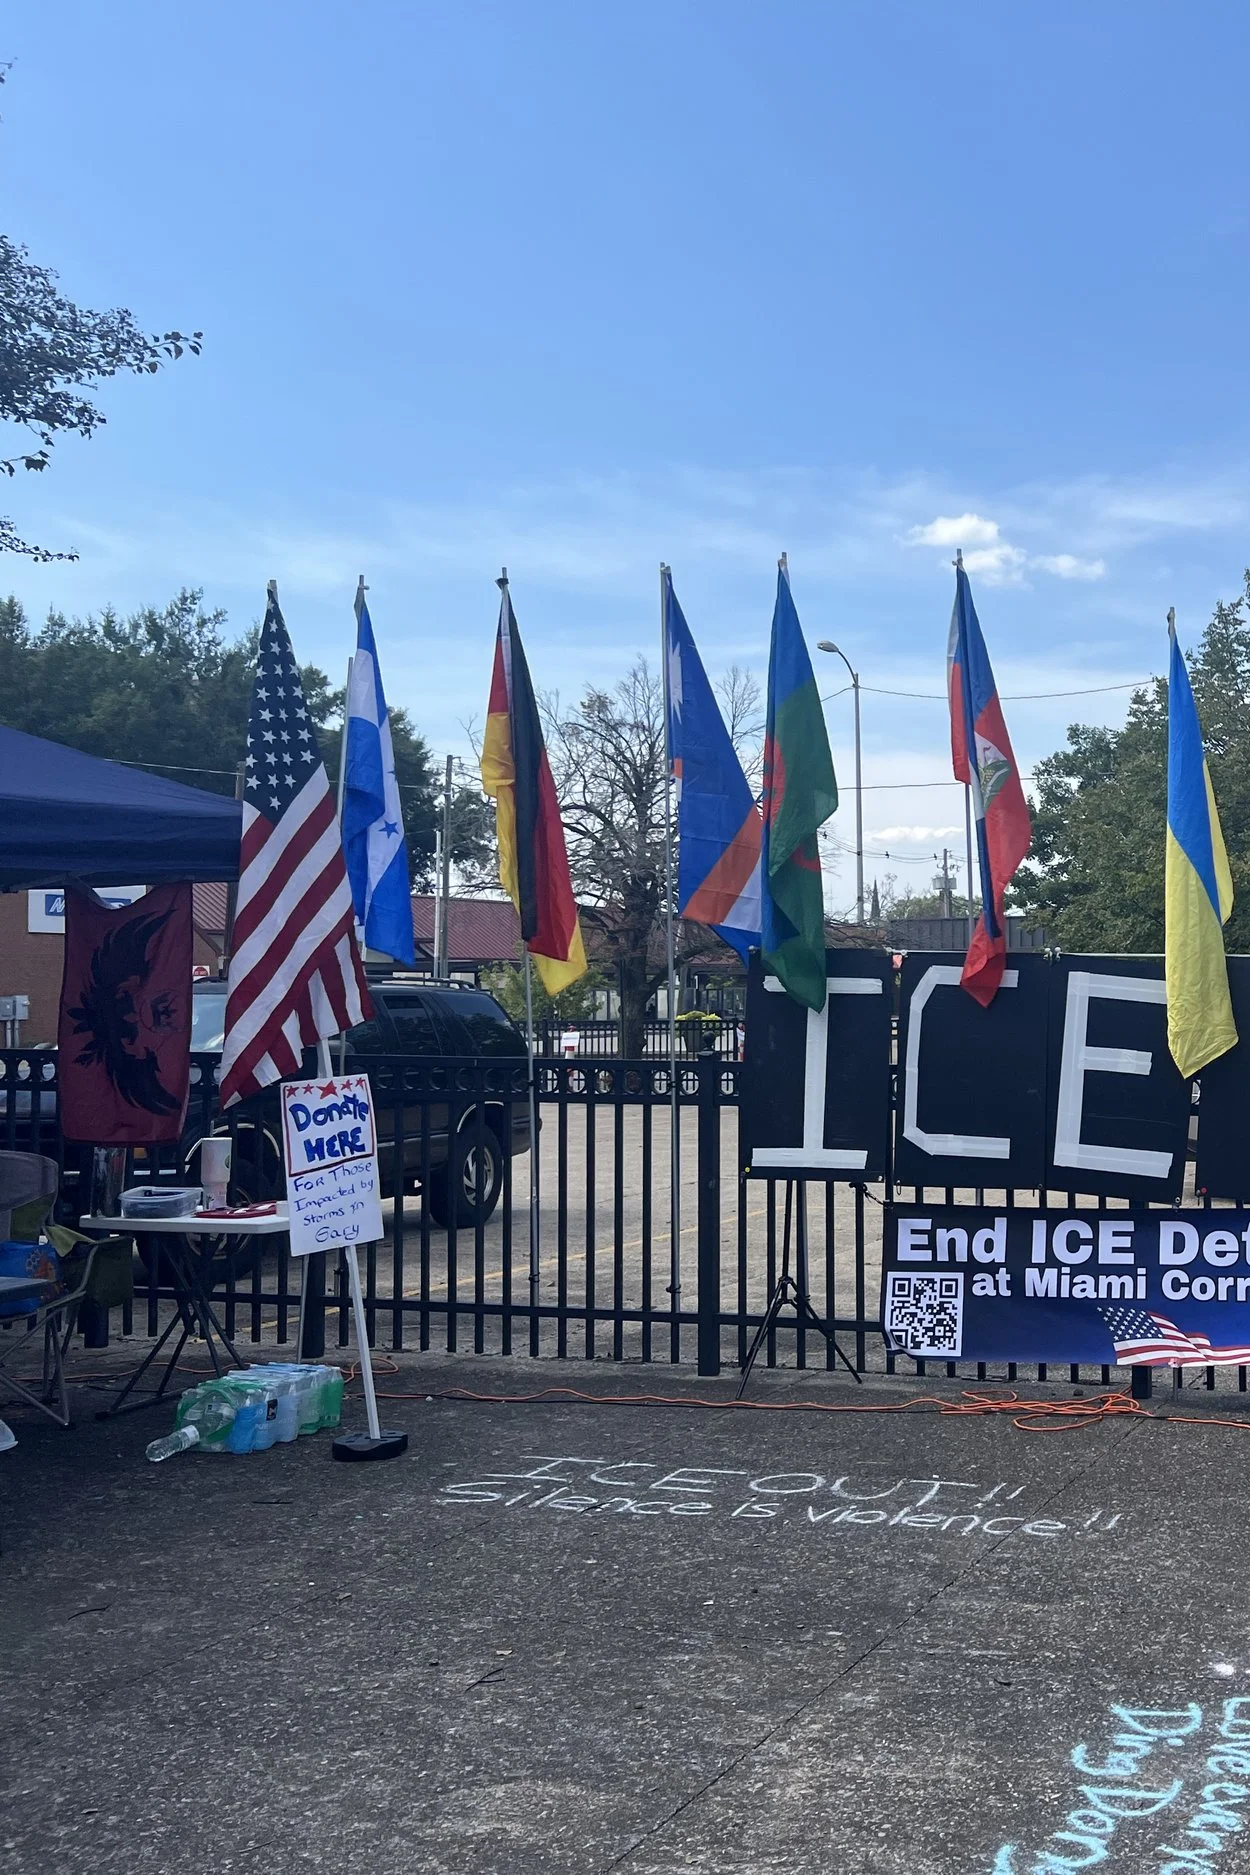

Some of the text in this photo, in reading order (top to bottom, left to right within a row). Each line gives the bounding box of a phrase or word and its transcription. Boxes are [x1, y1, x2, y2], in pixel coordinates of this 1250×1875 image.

[751, 964, 1174, 1178] ICE
[289, 1093, 369, 1132] Donate
[303, 1127, 366, 1163] HERE
[328, 1162, 372, 1182] Those
[294, 1179, 374, 1212] Impacted by
[315, 1224, 360, 1243] Gary
[897, 1217, 1008, 1264] End
[1031, 1219, 1135, 1265] ICE
[971, 1267, 1012, 1297] at
[1025, 1267, 1147, 1300] Miami
[481, 1455, 748, 1494] ICE
[435, 1481, 713, 1516] Silence
[731, 1497, 781, 1518] is
[1071, 1702, 1203, 1776] Ding
